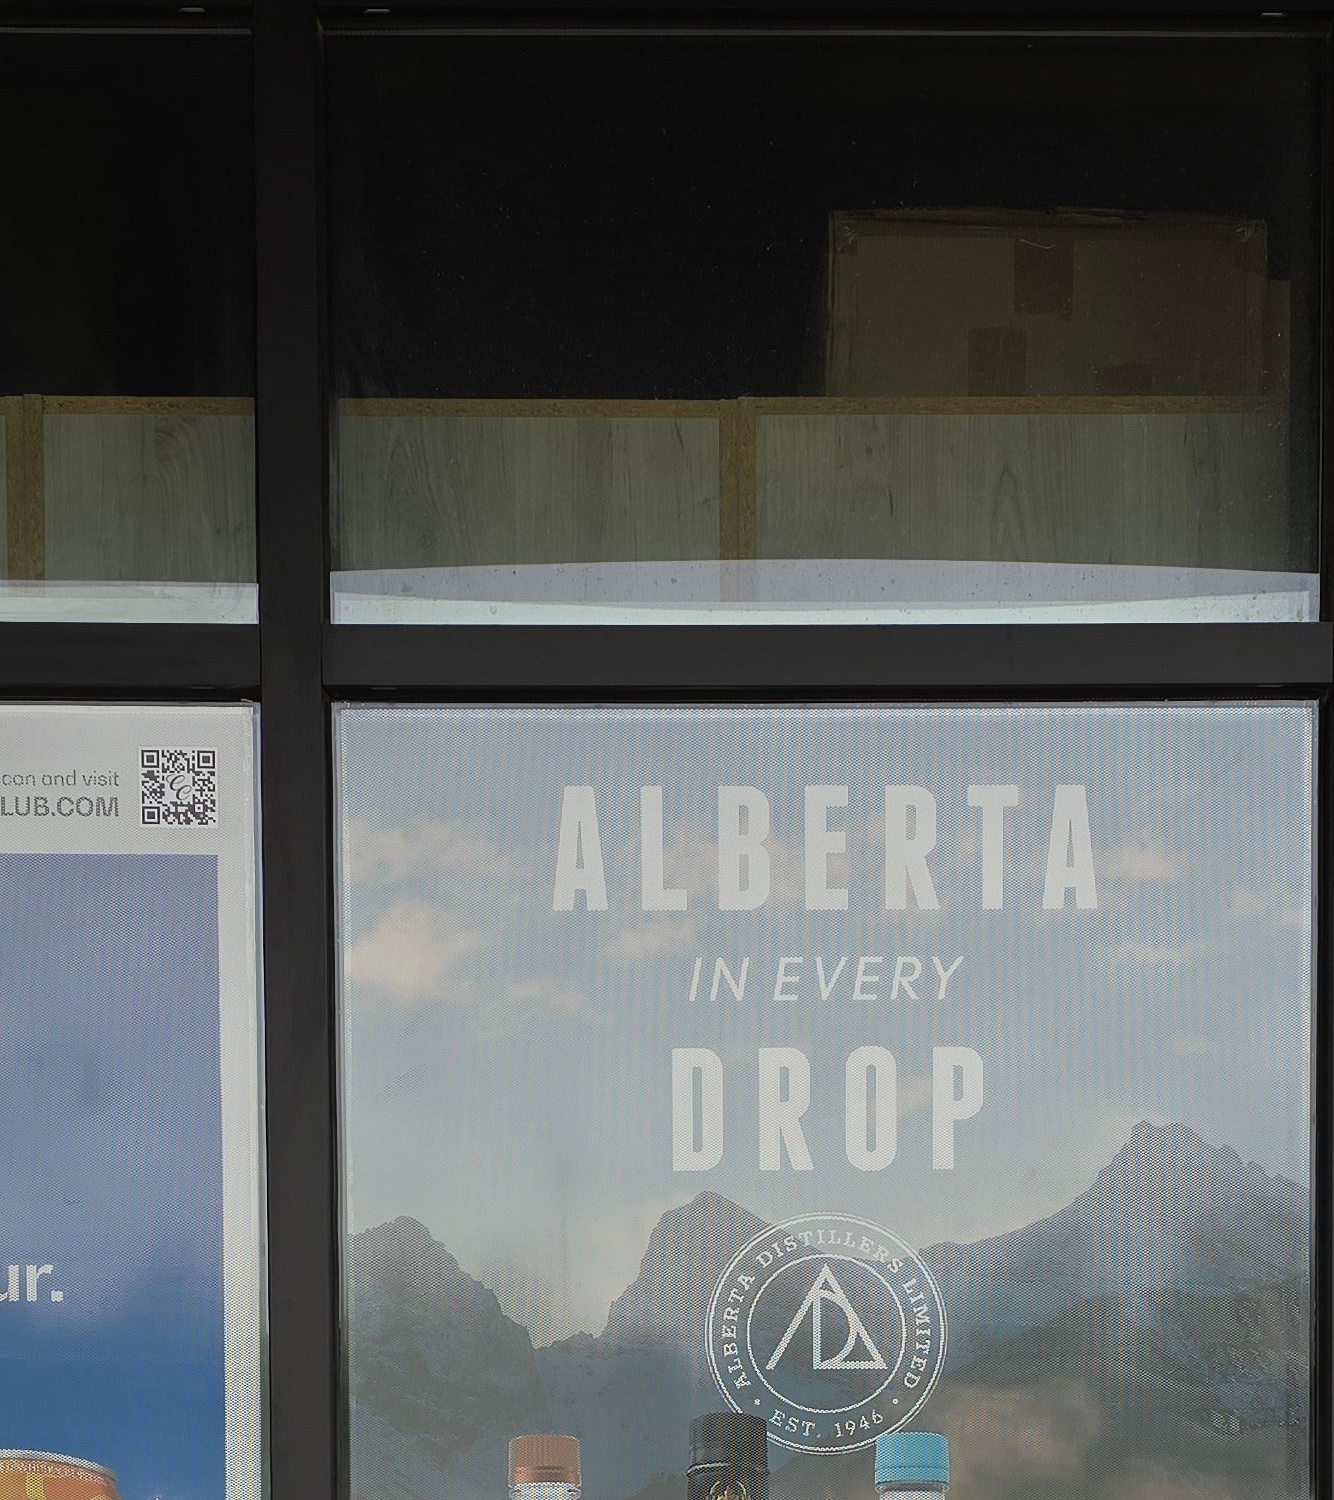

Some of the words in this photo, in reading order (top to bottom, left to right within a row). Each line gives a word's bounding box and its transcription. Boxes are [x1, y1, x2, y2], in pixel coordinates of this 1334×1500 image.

[41, 768, 77, 787] and
[82, 769, 120, 788] visit
[552, 784, 1099, 912] ALBERTA
[687, 956, 749, 1002] IN
[773, 955, 966, 1002] EVERY
[671, 1045, 984, 1173] DROP
[721, 1271, 755, 1389] ALBERTA
[755, 1229, 904, 1275] DISTILLERS
[901, 1278, 932, 1389] LIMITED
[768, 1408, 821, 1439] EST.
[834, 1409, 884, 1438] 1946
